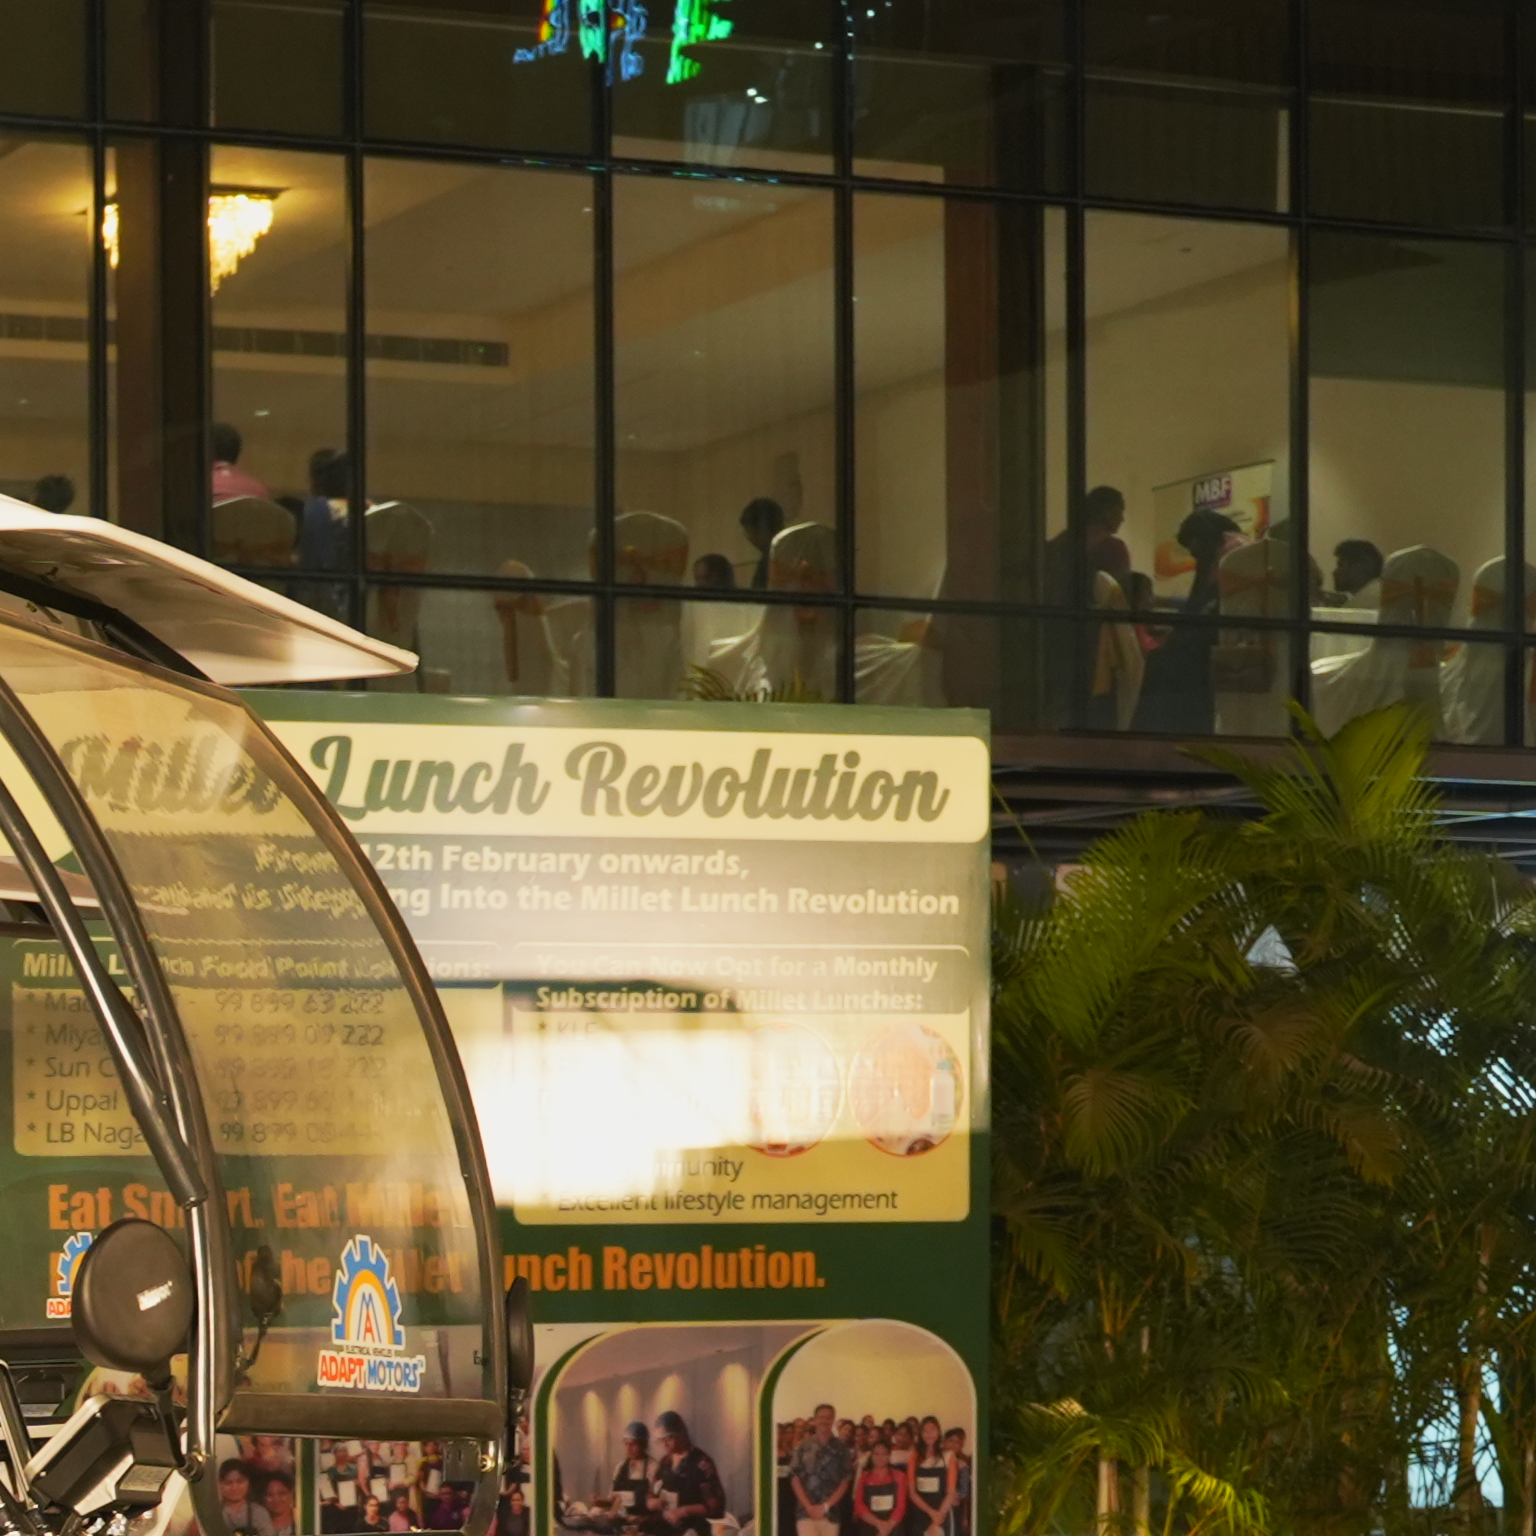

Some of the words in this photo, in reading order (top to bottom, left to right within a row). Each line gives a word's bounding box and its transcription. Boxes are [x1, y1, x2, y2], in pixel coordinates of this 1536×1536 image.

[310, 735, 551, 821] Lunch
[565, 740, 951, 823] Revolution
[441, 844, 590, 878] February
[599, 847, 750, 880] onwards,
[440, 885, 508, 914] Into
[516, 885, 572, 913] the
[581, 885, 674, 914] Millet
[682, 886, 779, 915] Lunch
[787, 888, 961, 917] Revolution
[23, 952, 77, 978] Mill
[537, 954, 590, 976] You
[593, 955, 643, 977] Can
[649, 956, 712, 977] Now
[715, 956, 767, 983] Opt
[770, 955, 808, 978] for
[812, 960, 827, 978] a
[834, 956, 939, 984] Monthly
[536, 986, 698, 1014] Subscription
[703, 988, 731, 1010] of
[736, 988, 808, 1011] Millet
[817, 990, 924, 1012] Lunches:
[44, 1022, 106, 1052] Miya
[44, 1056, 91, 1078] Sun
[45, 1089, 118, 1117] Uppal
[45, 1121, 76, 1144] LB
[83, 1121, 146, 1150] Naga
[46, 1182, 112, 1231] Eat
[663, 1188, 745, 1216] lifestyle
[752, 1190, 899, 1214] management
[280, 1248, 332, 1295] he
[602, 1244, 827, 1291] Revolution.
[320, 1354, 365, 1384] ADAPT
[368, 1359, 418, 1388] MOTORS
